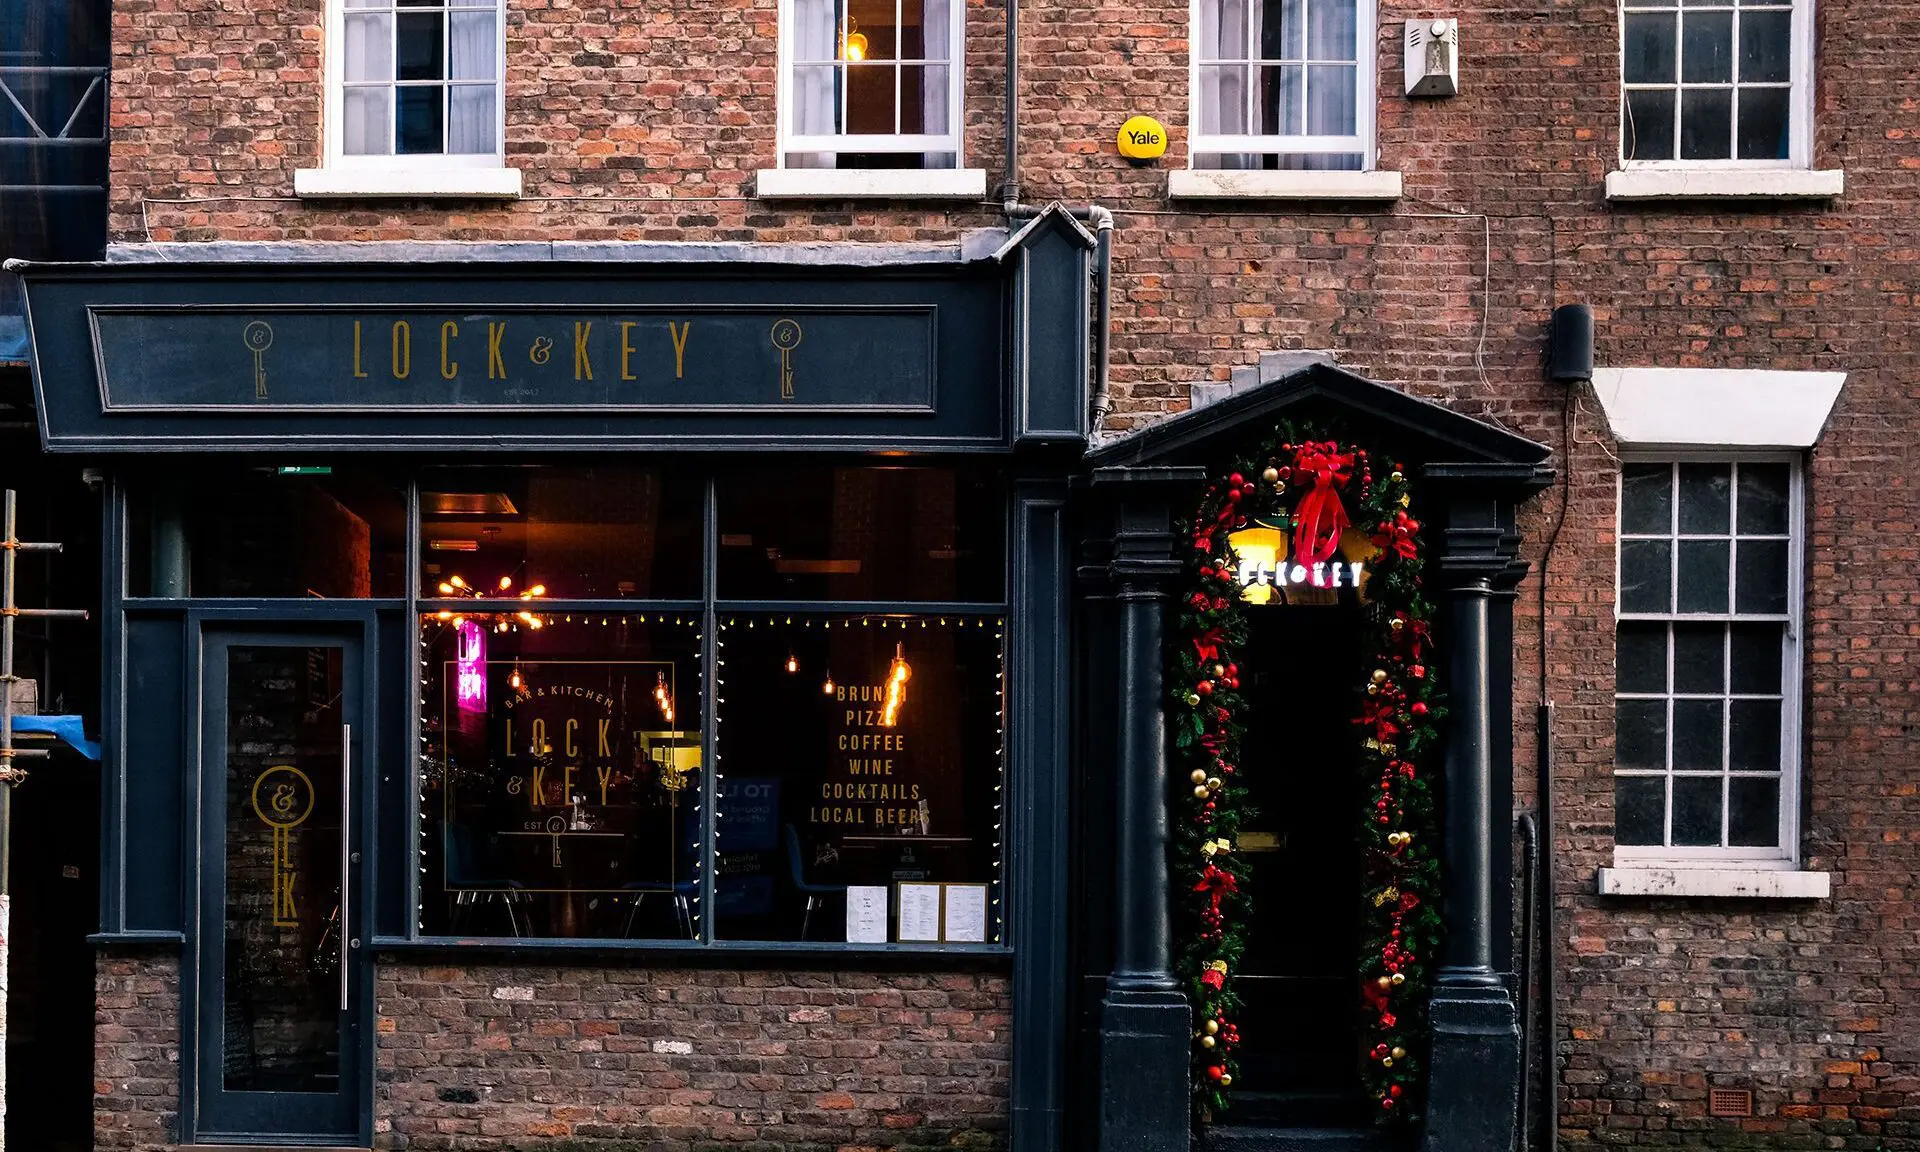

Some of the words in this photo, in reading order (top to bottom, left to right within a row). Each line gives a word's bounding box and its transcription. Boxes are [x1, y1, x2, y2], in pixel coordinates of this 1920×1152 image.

[1128, 131, 1159, 145] Yale
[354, 320, 508, 380] LOCK
[529, 336, 553, 365] &
[574, 321, 691, 380] KEY
[505, 690, 532, 709] BAR
[537, 688, 545, 697] &
[551, 685, 614, 709] KITCHEN
[837, 685, 907, 702] BRUNH
[846, 710, 897, 727] PIZZ
[506, 718, 612, 758] LOCK
[839, 734, 904, 751] COFFEE
[849, 759, 893, 775] WINE
[506, 775, 523, 795] &
[533, 766, 612, 806] KEY
[822, 783, 920, 800] COCKTAILS
[271, 784, 296, 811] &
[811, 806, 865, 824] LOCAL
[524, 821, 542, 830] EST
